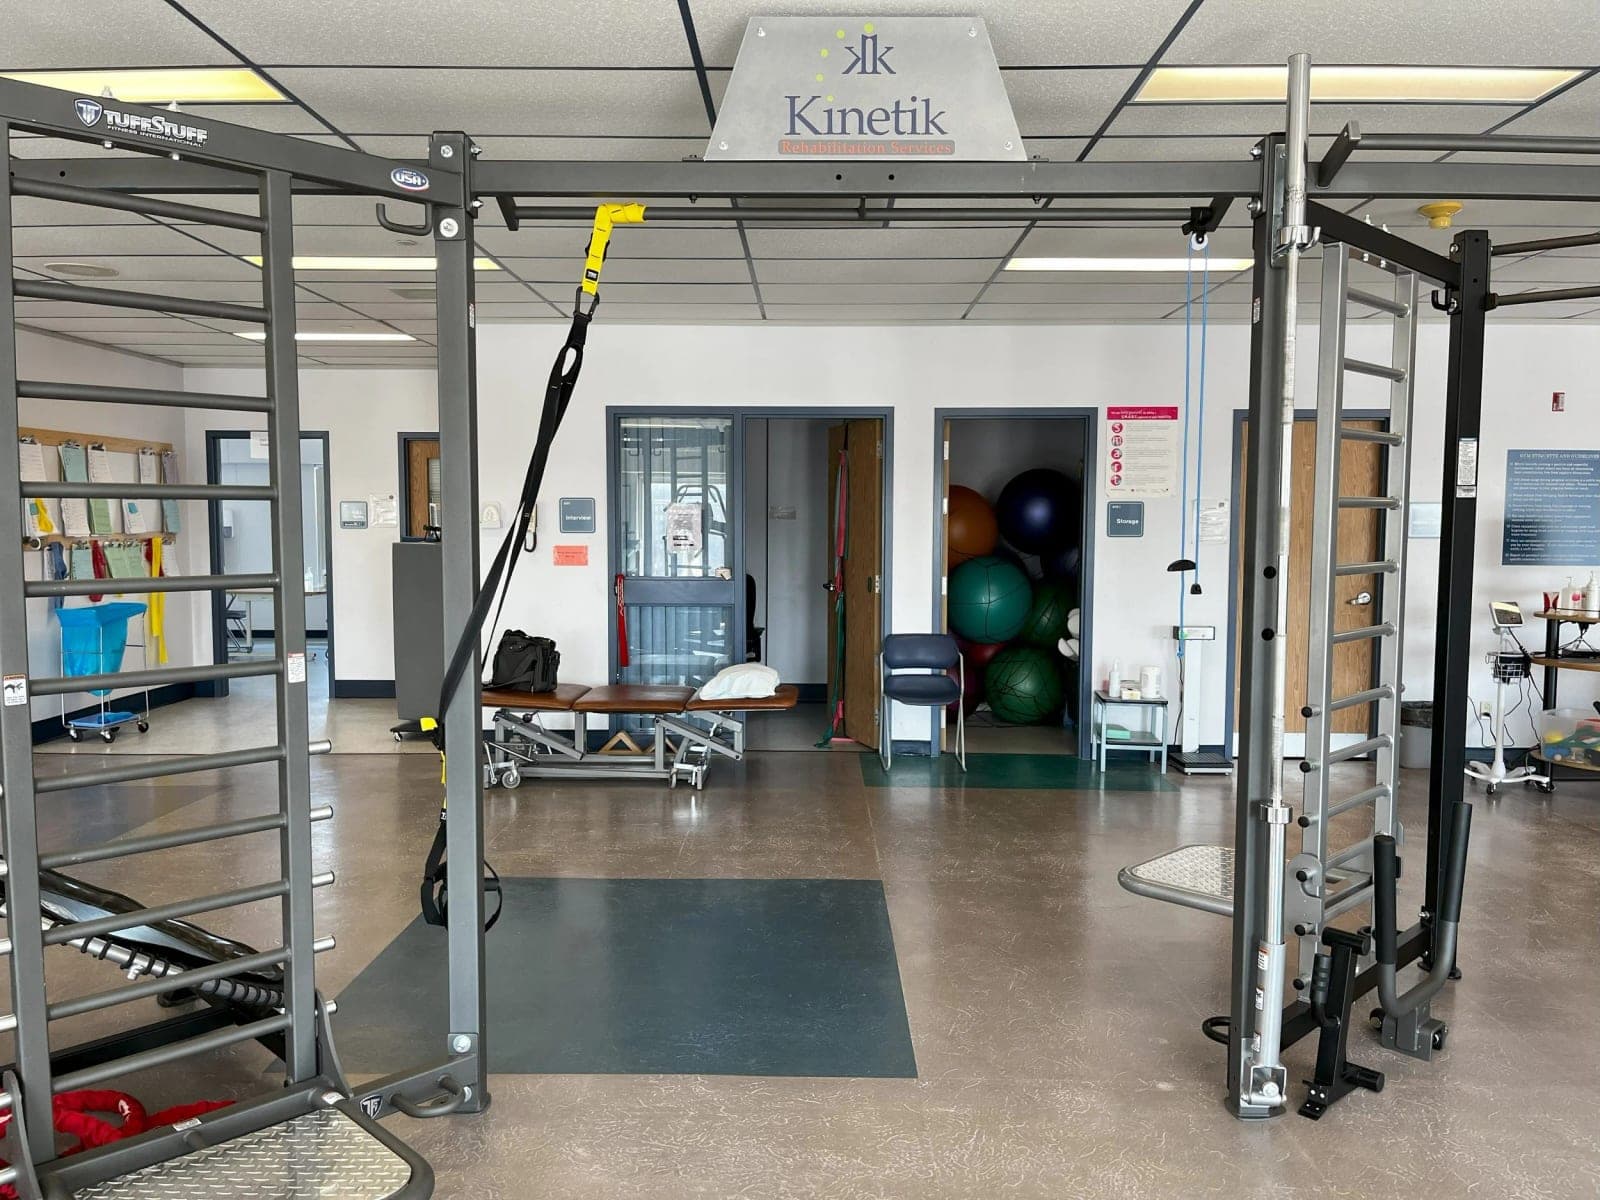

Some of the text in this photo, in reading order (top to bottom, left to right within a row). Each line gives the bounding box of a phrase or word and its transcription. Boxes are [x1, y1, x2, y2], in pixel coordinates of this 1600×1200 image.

[784, 94, 948, 136] Kinetik
[107, 125, 203, 148] FITNESS INTERNATIONAL
[782, 140, 951, 154] Rehabilitation Services
[395, 172, 422, 186] USA
